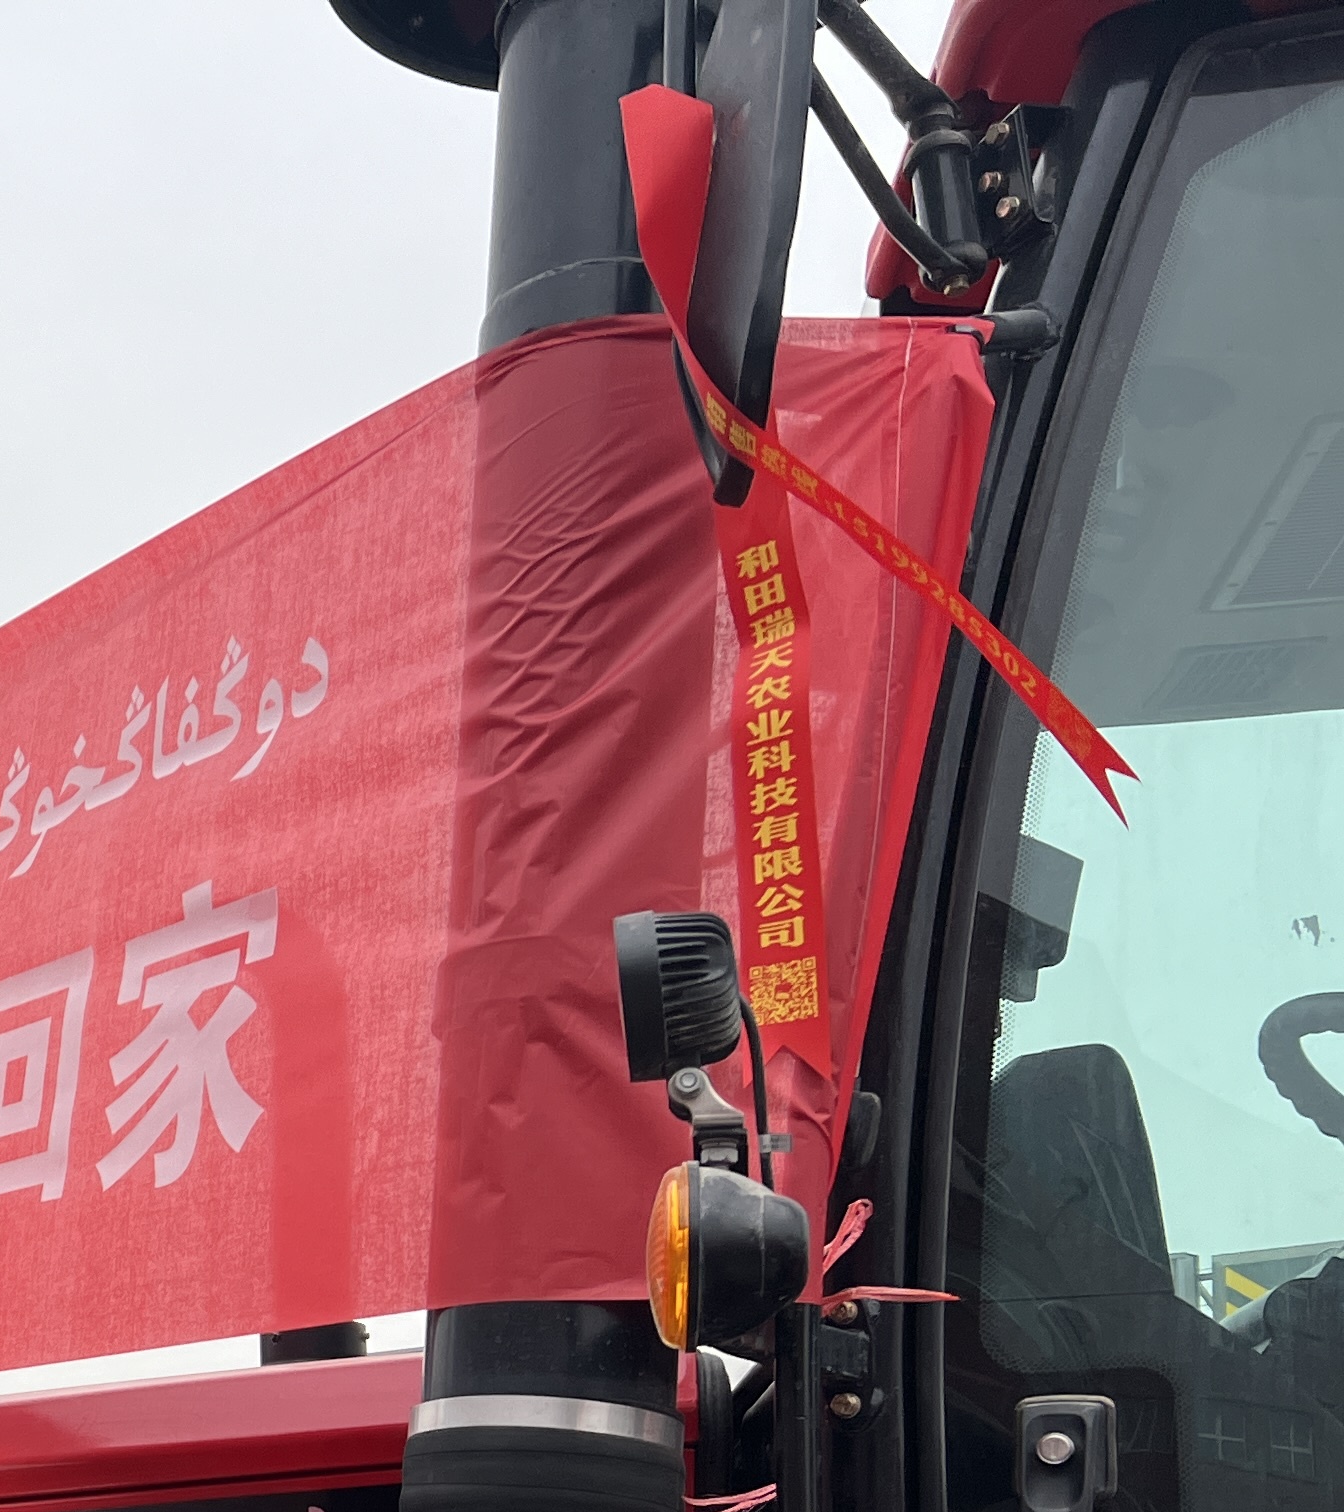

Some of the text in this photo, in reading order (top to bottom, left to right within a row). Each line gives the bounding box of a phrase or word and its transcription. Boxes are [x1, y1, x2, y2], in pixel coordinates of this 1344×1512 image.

[735, 538, 806, 949] 和田瑞天农业科技有限公司
